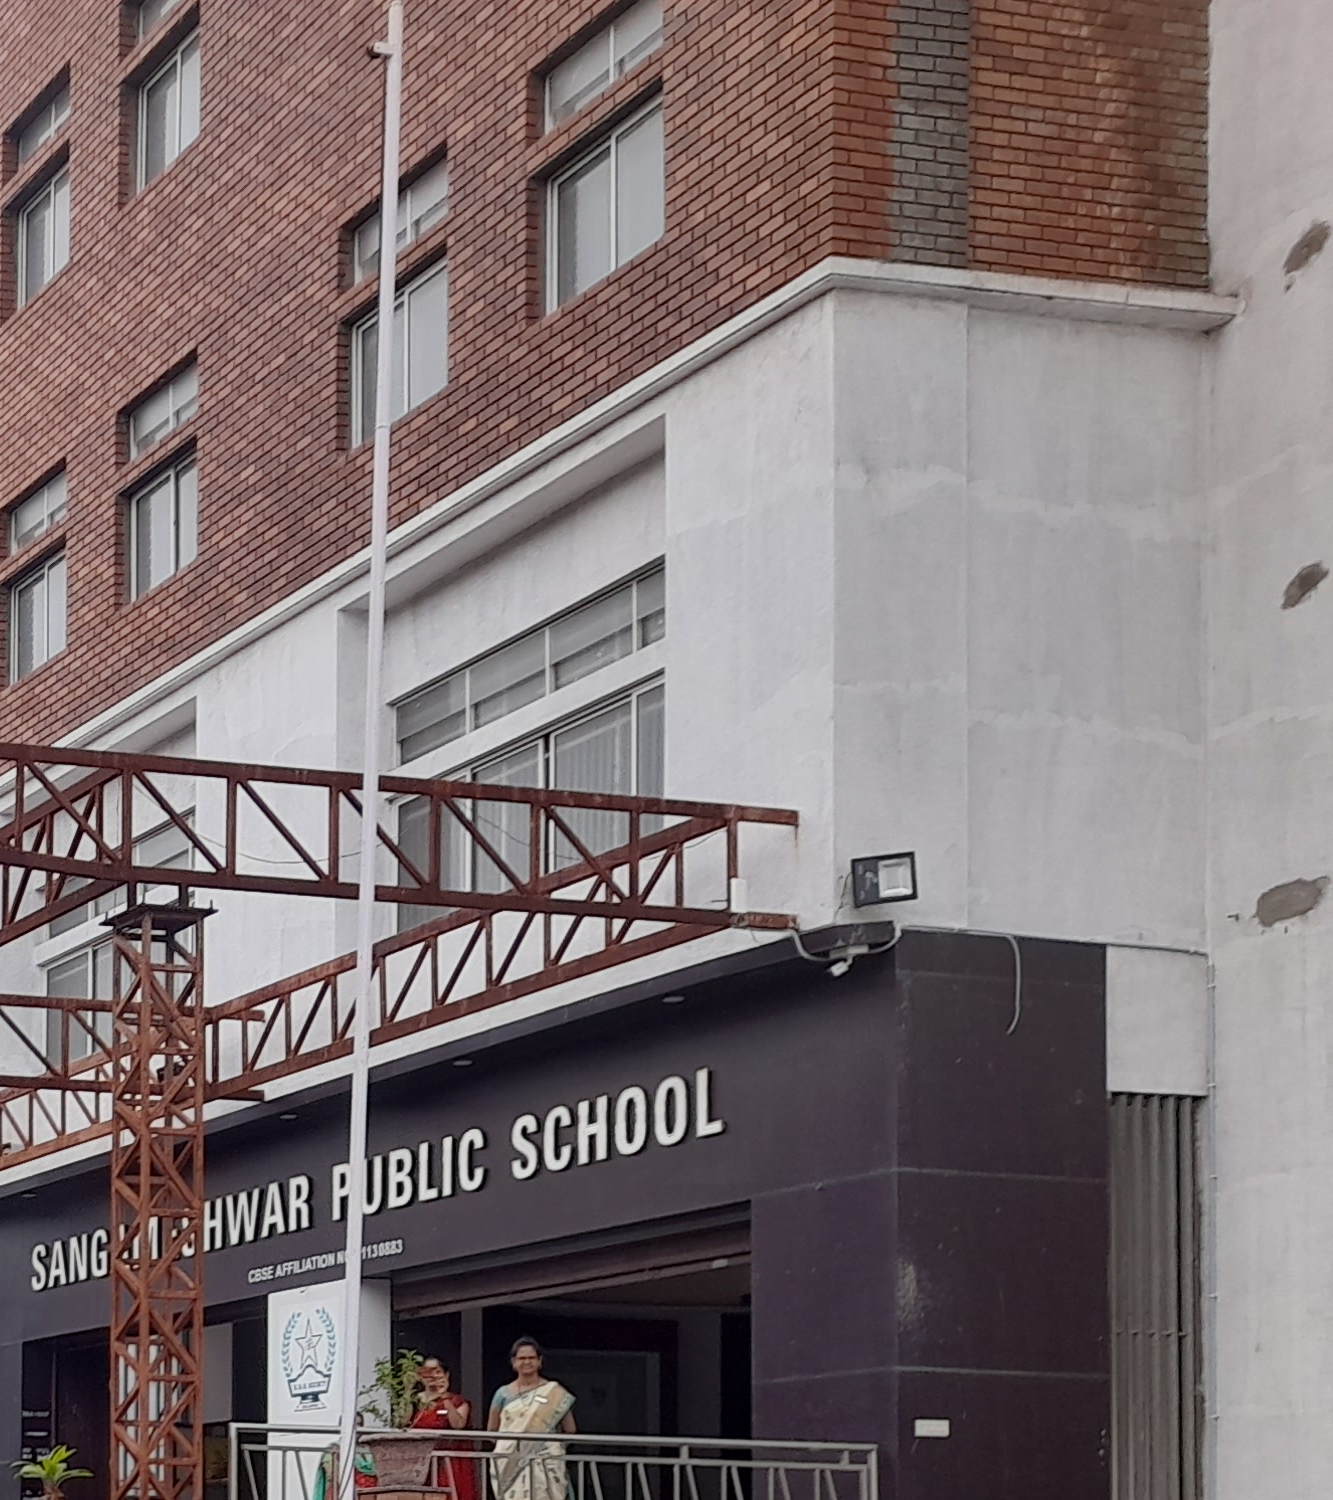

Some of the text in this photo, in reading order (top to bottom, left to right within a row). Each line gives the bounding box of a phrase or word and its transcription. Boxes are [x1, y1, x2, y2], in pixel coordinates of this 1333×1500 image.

[510, 1067, 725, 1181] SCHOOL
[247, 1265, 274, 1284] CBSE
[275, 1252, 335, 1278] AFFILIATION
